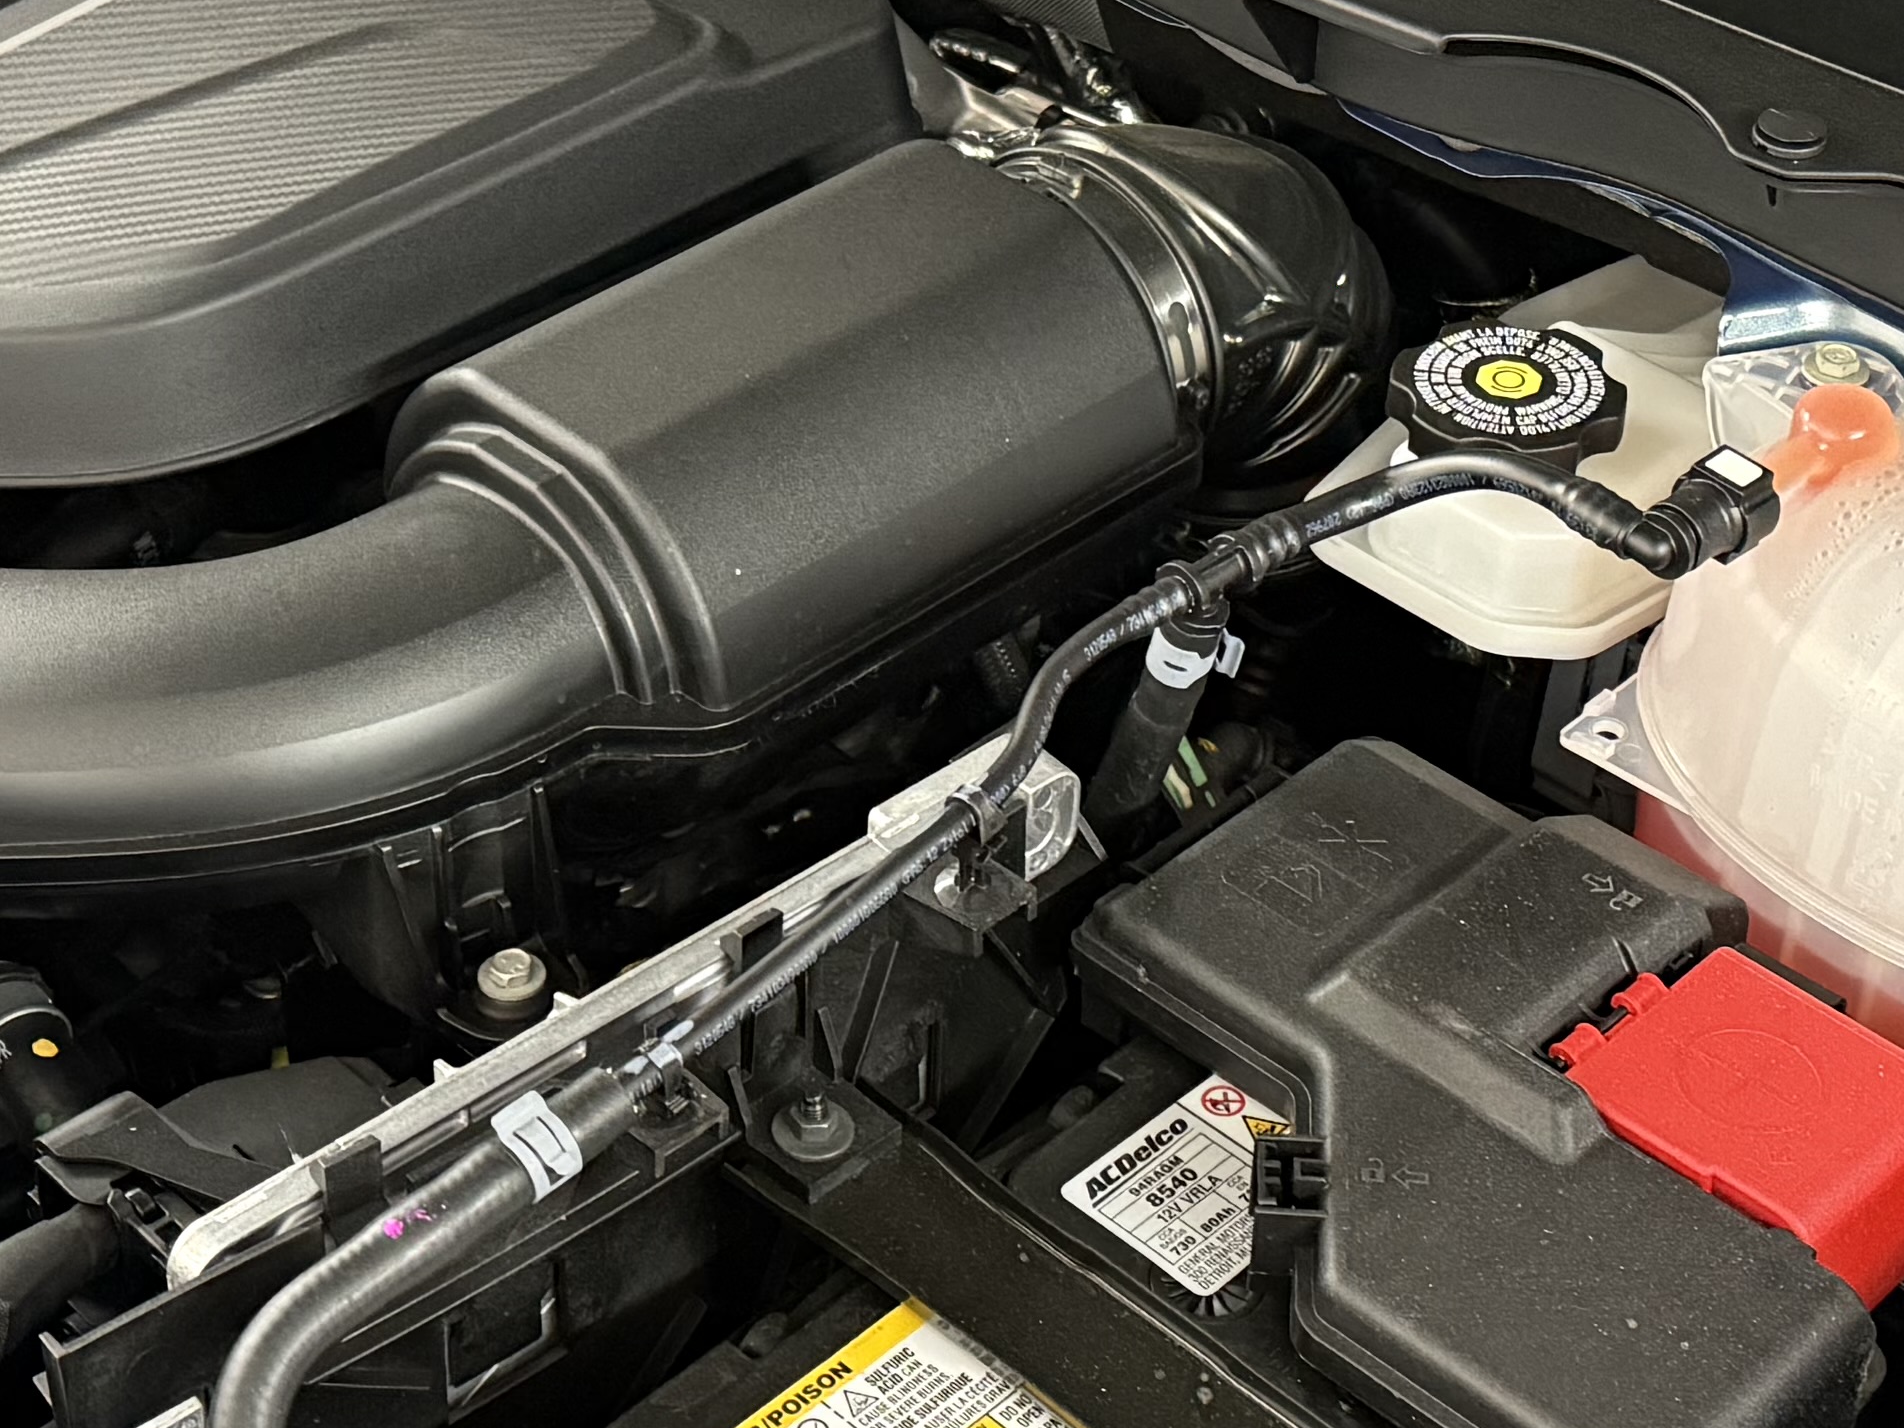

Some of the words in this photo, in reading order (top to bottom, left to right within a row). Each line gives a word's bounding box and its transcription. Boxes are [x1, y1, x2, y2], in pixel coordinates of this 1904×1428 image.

[1085, 1118, 1188, 1200] ACDelco
[1146, 1168, 1199, 1207] 8540
[1157, 1202, 1183, 1224] 12V
[1180, 1175, 1223, 1205] VRLA
[1200, 1206, 1236, 1233] 80Ah
[1170, 1236, 1197, 1256] 730
[1178, 1241, 1221, 1274] GENERAL
[1188, 1265, 1209, 1282] 300
[1198, 1256, 1241, 1290] DETROIT,
[862, 1346, 916, 1387] SULFURIC
[874, 1371, 905, 1395] ACID
[898, 1357, 924, 1377] CAN
[856, 1400, 891, 1427] CAUSE
[885, 1363, 940, 1405] BLINDNESS
[912, 1371, 974, 1419] SULFURIQUE
[951, 1395, 969, 1410] LA
[982, 1379, 1013, 1403] GRAV
[998, 1404, 1019, 1421] DO
[1012, 1392, 1034, 1410] NO
[882, 1394, 921, 1425] SEVERE
